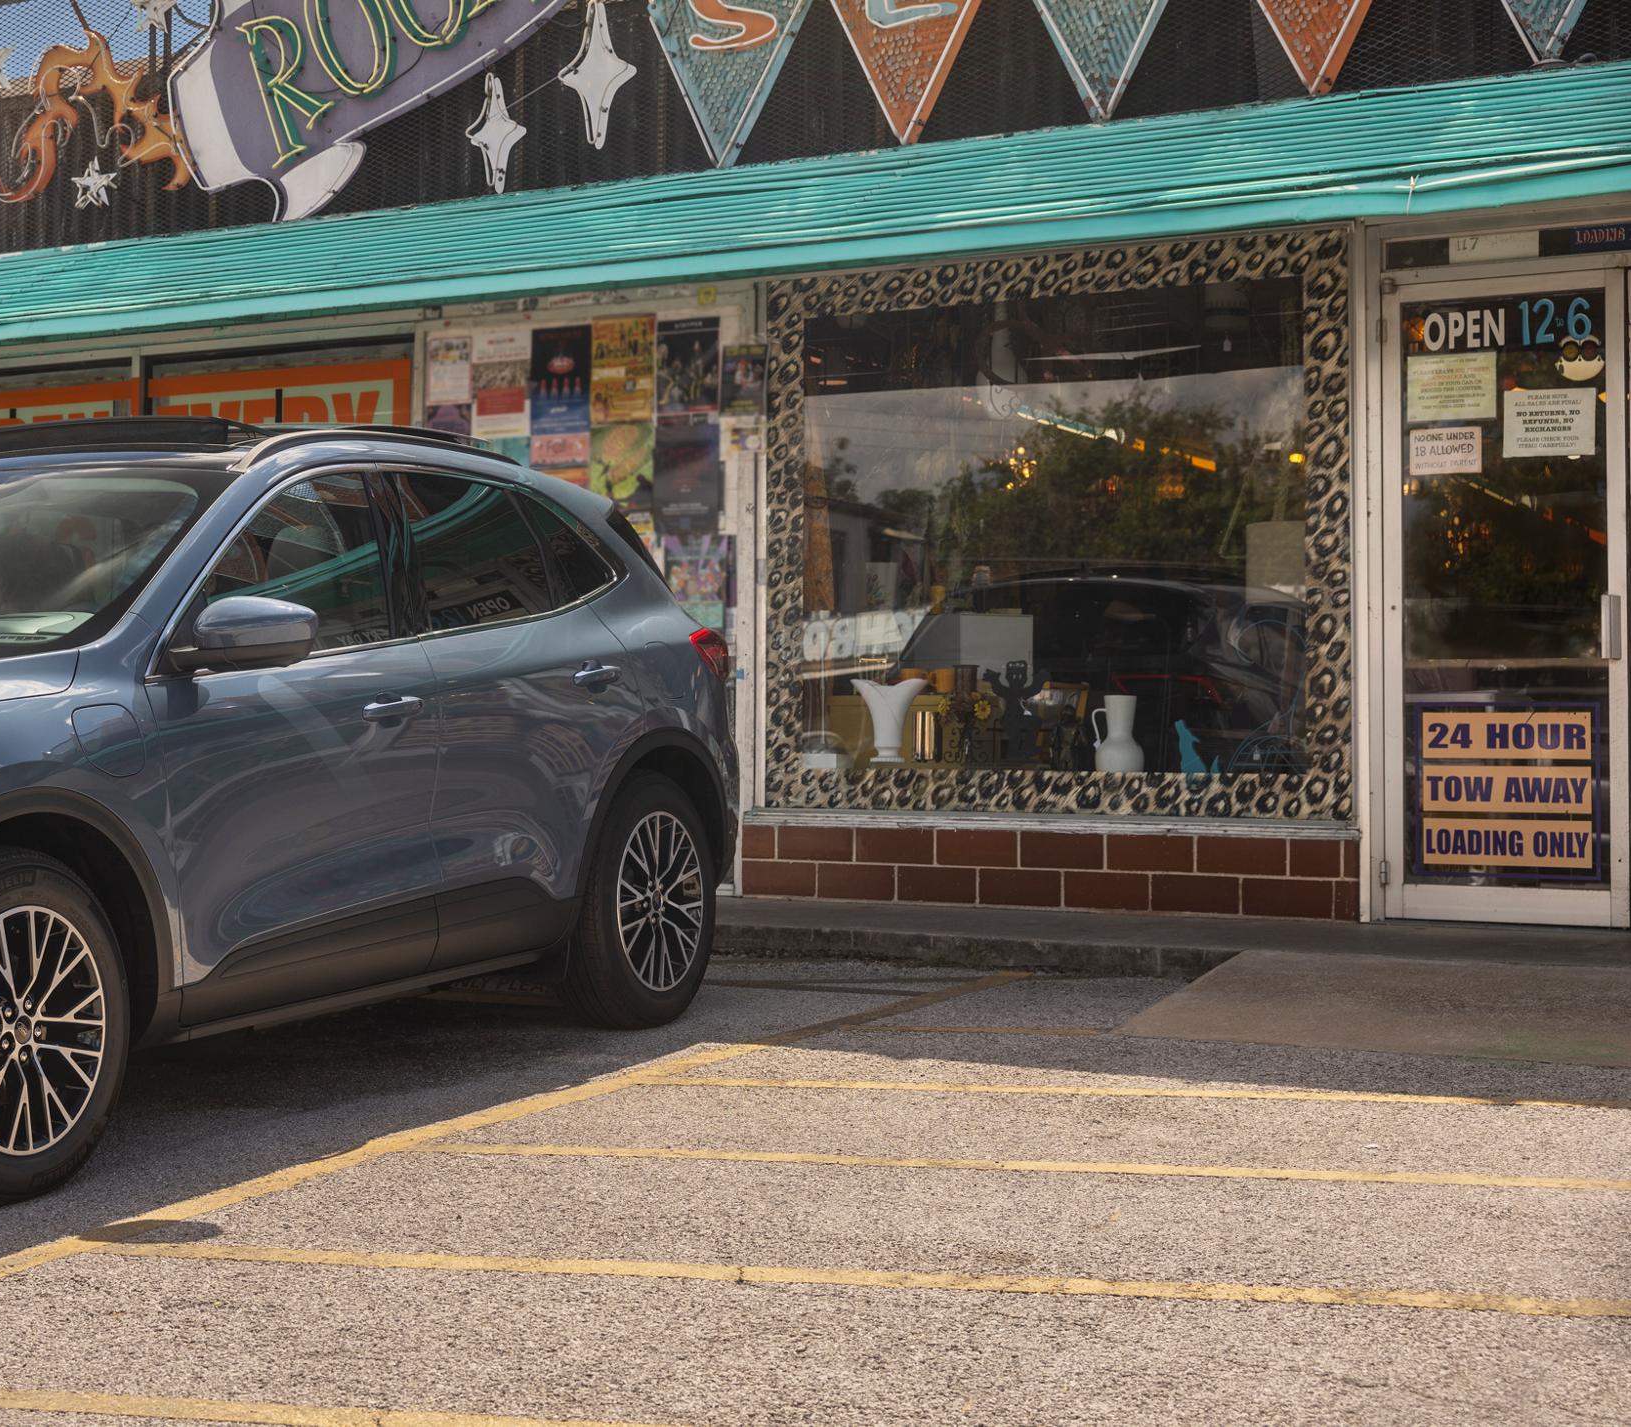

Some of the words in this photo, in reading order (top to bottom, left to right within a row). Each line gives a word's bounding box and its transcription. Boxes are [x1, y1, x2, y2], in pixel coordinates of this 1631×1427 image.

[1576, 227, 1626, 244] LOADING
[1424, 308, 1505, 351] OPEN
[1519, 298, 1555, 346] 12
[1567, 297, 1592, 341] 6
[1415, 446, 1426, 456] 18
[1429, 443, 1474, 456] ALLOWED
[1426, 433, 1444, 441] ONE
[1446, 431, 1476, 440] UNDER
[1427, 723, 1473, 749] 24
[1486, 723, 1587, 750] HOUR
[1426, 775, 1494, 802] TOW
[1503, 776, 1588, 804] AWAY
[1425, 828, 1524, 857] LOADING
[1533, 831, 1589, 858] ONLY
